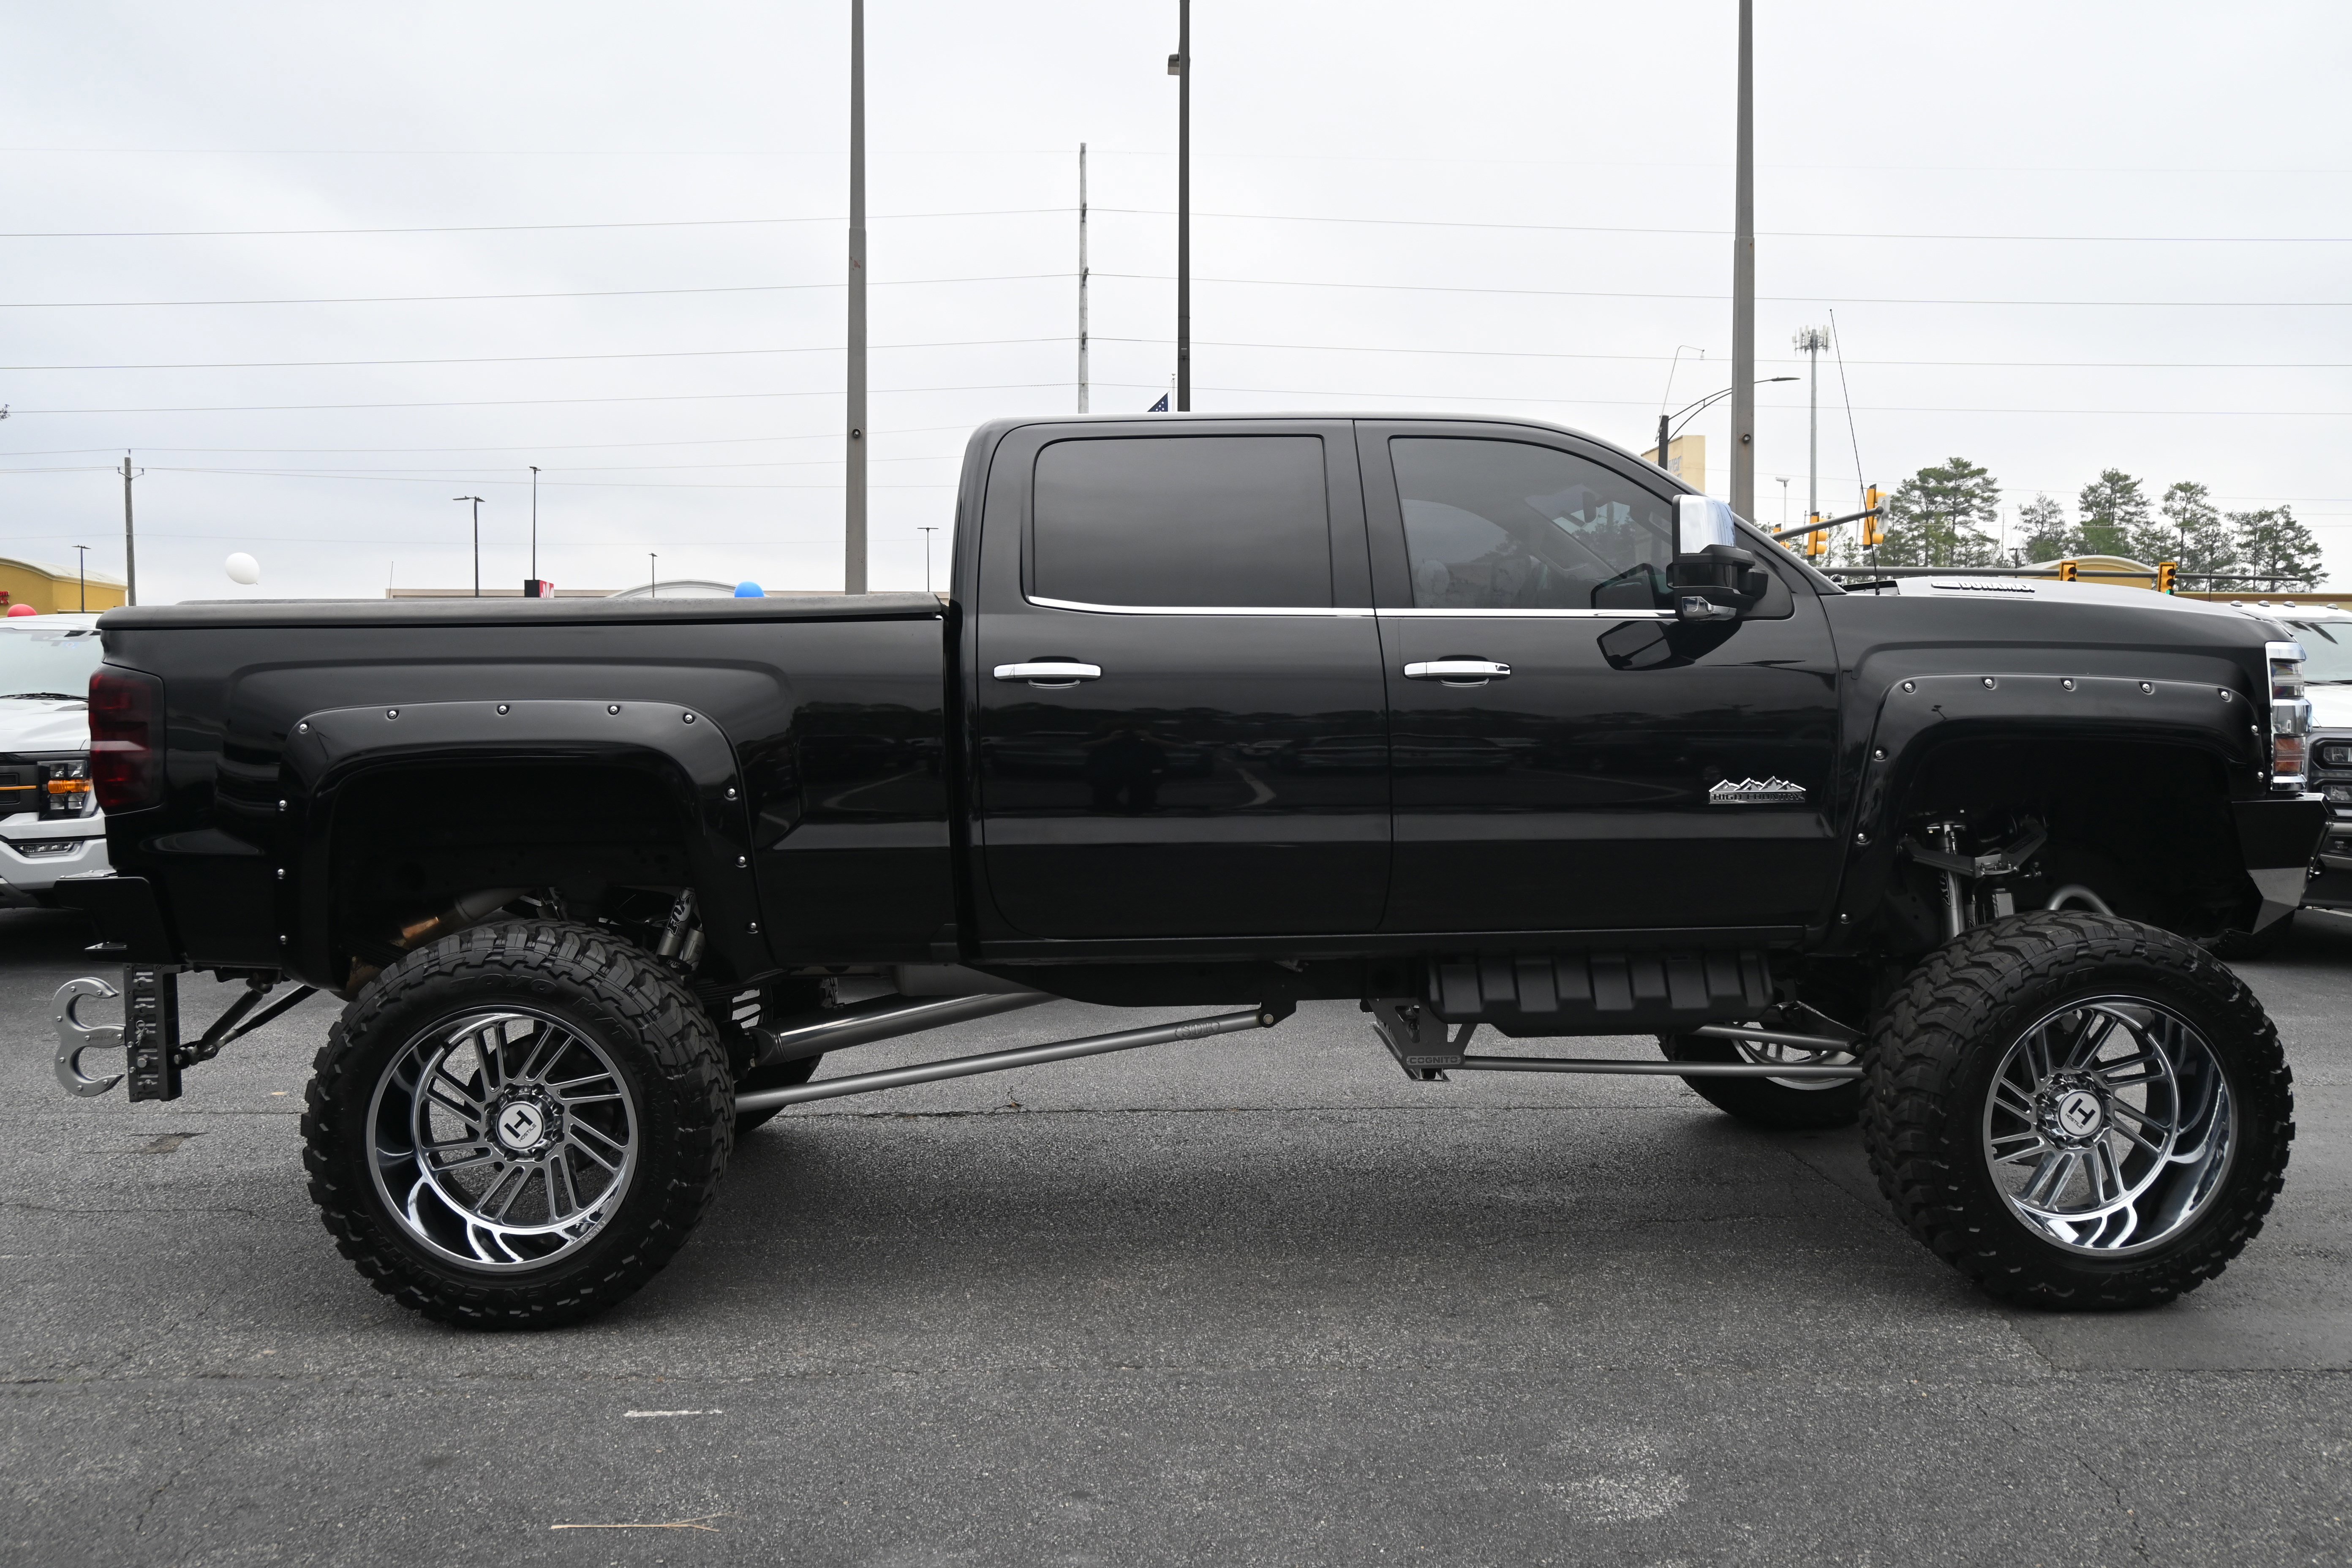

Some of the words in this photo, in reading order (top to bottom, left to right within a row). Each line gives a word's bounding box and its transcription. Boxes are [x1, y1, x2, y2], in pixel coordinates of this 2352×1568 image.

[1960, 581, 2035, 593] DURAMAX
[1713, 793, 1742, 801] HIGH
[1747, 792, 1801, 801] COUNTRY
[666, 891, 693, 936] FOX
[666, 959, 681, 969] FOX
[2036, 967, 2095, 1000] M/T
[449, 973, 557, 994] TOYO
[572, 996, 633, 1043] M/T
[1181, 1021, 1215, 1037] SOR
[504, 1110, 533, 1139] H
[2065, 1113, 2084, 1130] HOSTILE
[2068, 1097, 2096, 1126] H
[518, 1123, 537, 1142] HOSTILE
[582, 1218, 608, 1244] HOSTILE
[351, 1210, 490, 1301] COUNTRY
